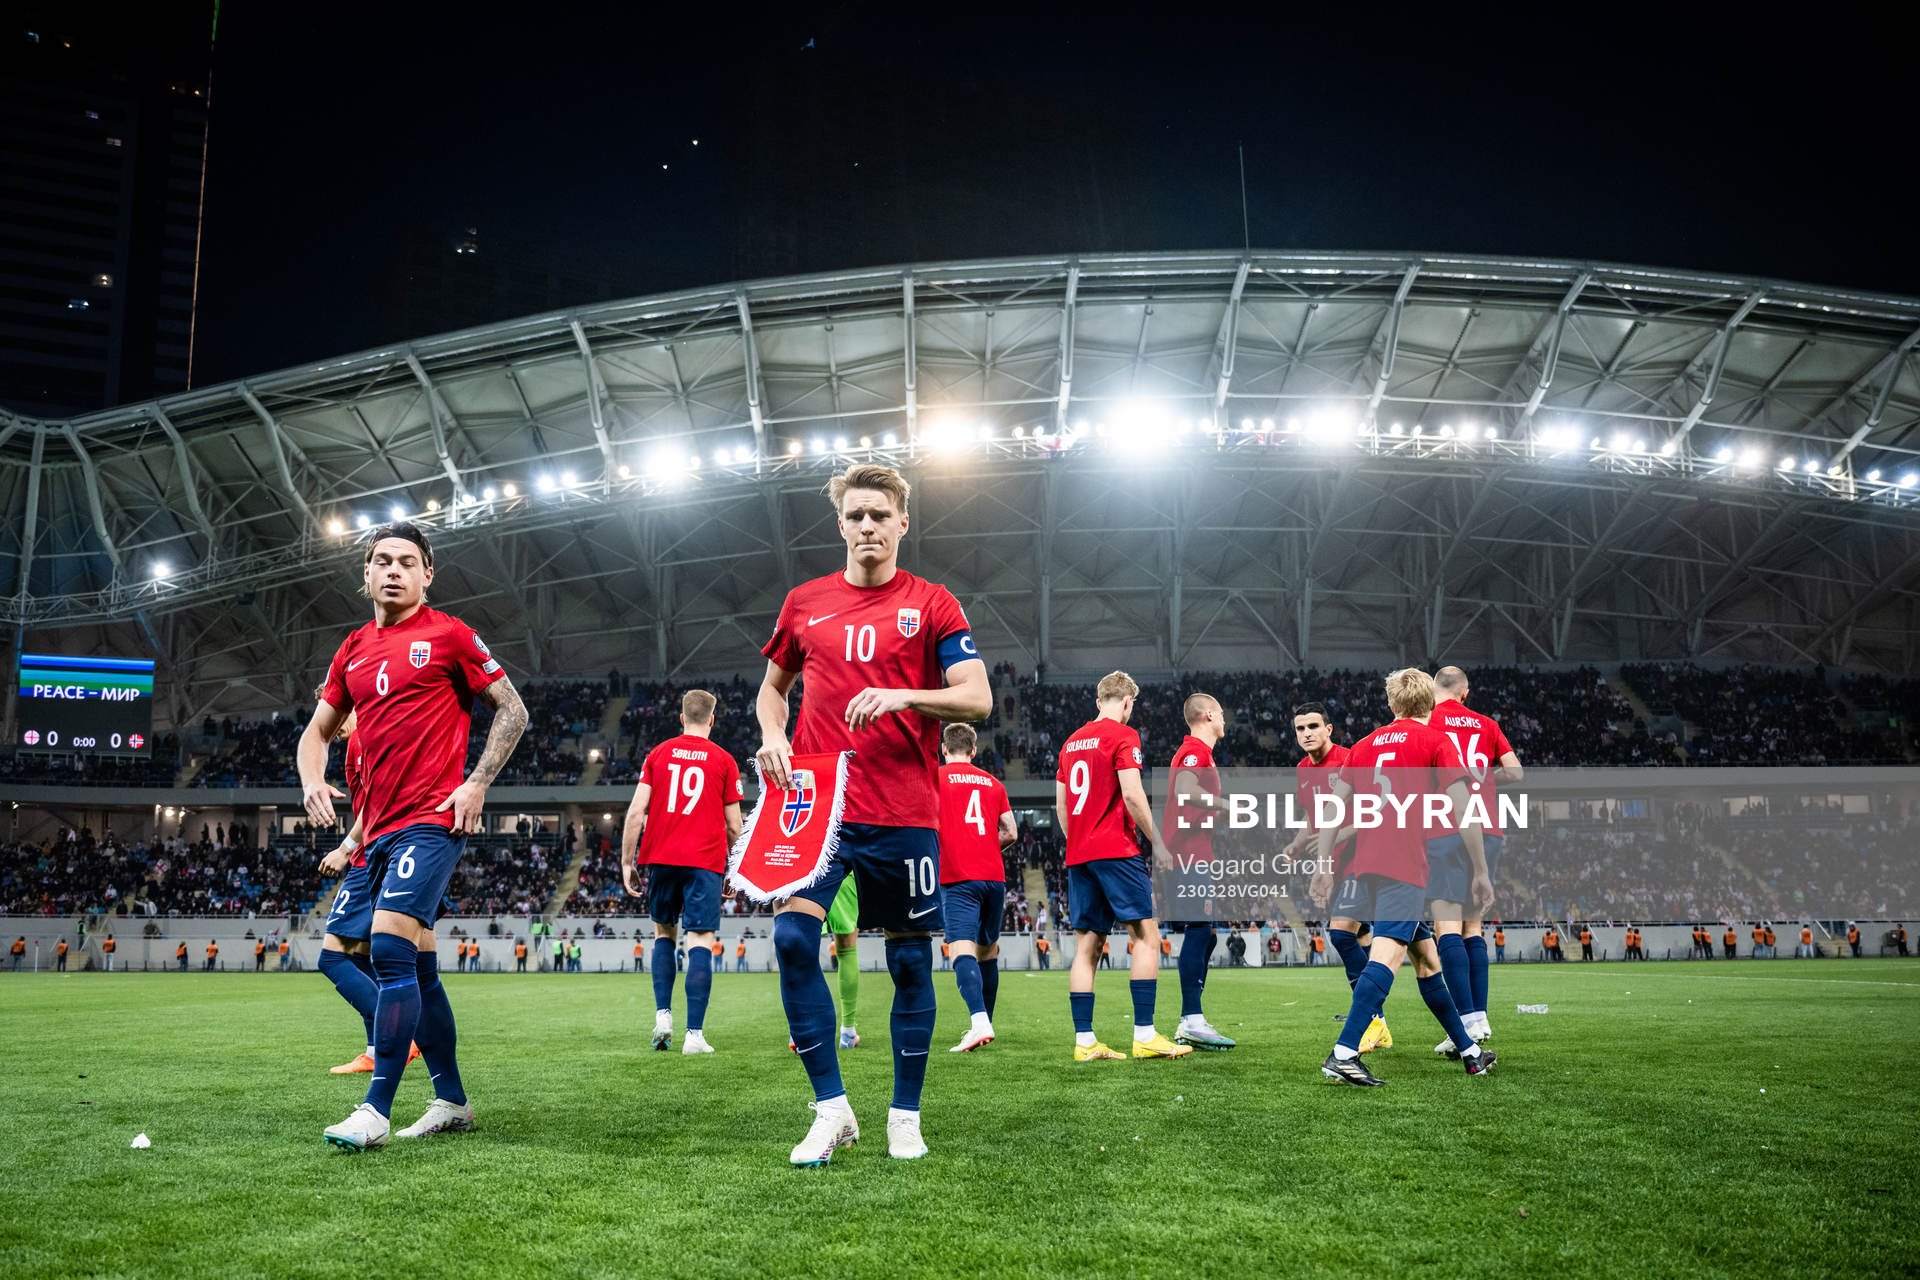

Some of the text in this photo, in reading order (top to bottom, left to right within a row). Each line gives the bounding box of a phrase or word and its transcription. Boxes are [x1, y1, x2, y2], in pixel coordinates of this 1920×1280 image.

[844, 624, 877, 663] 10
[960, 636, 977, 654] C
[33, 684, 85, 699] PEACE
[101, 687, 140, 701] МИР
[376, 661, 389, 696] 6
[1444, 716, 1482, 729] AURSNES
[47, 731, 122, 748] 0 0:00 0
[1372, 732, 1408, 747] MELING
[666, 763, 705, 816] 19
[948, 773, 993, 787] STRANDBERG
[1069, 760, 1090, 815] 9
[1372, 752, 1396, 812] 5
[964, 789, 986, 836] 4
[397, 845, 416, 879] 6
[904, 856, 936, 897] 10
[331, 889, 351, 915] 2
[1342, 879, 1358, 899] 11
